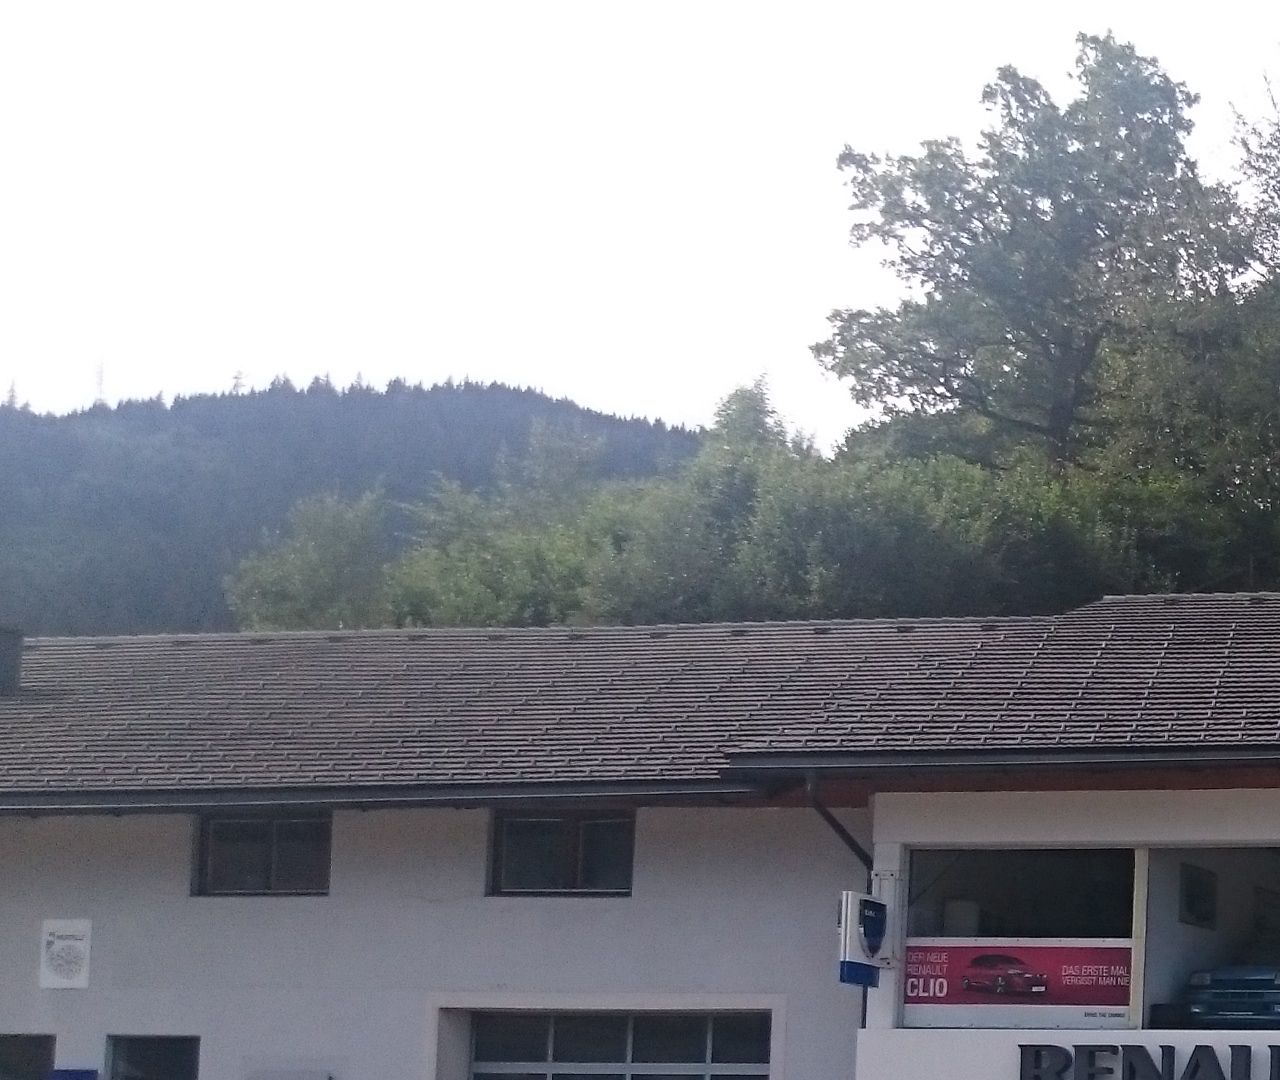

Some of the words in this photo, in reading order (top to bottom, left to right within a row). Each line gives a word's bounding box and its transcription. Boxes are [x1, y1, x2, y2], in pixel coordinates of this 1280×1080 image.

[907, 952, 925, 962] DER
[926, 952, 949, 963] NEUE
[907, 964, 949, 975] RENAULT
[1061, 965, 1080, 976] DAS
[1081, 966, 1109, 976] ERSTE
[1110, 966, 1130, 976] MAL
[1061, 976, 1097, 985] VERGISST
[1098, 977, 1116, 985] MAN
[906, 978, 948, 997] CLIO
